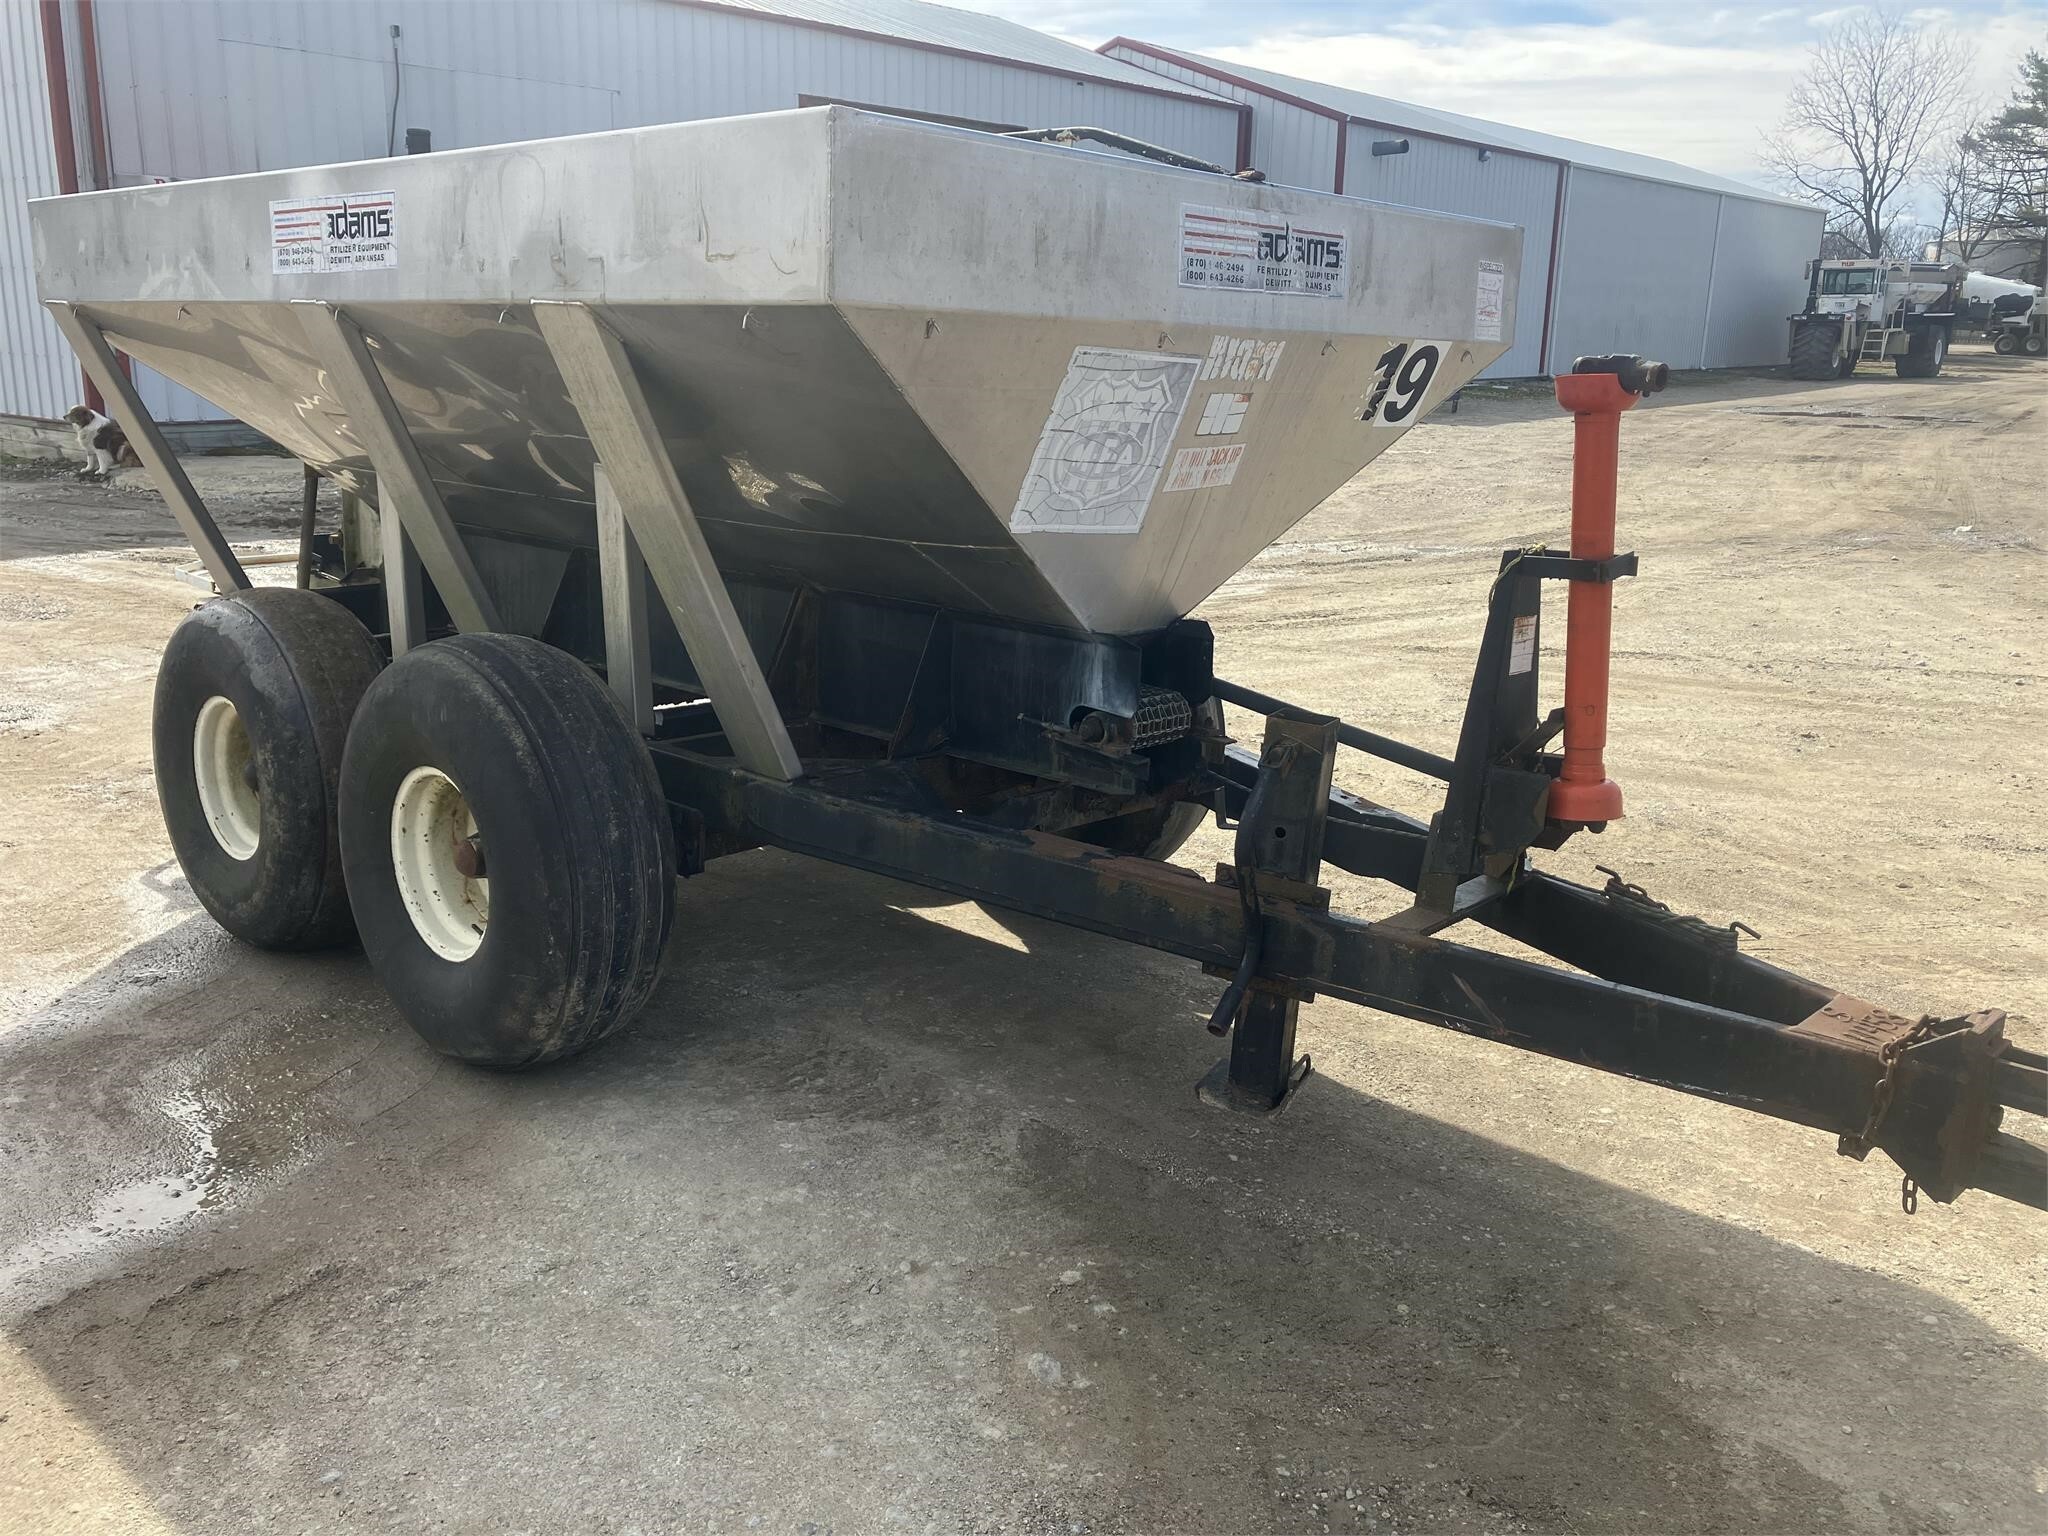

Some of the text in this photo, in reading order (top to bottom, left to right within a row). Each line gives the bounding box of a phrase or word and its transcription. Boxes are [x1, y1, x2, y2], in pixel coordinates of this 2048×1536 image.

[357, 243, 390, 252] EQUIPMENT
[1186, 257, 1244, 273] (870) 46-2494
[1186, 271, 1206, 282] (800)
[1360, 343, 1440, 423] 19
[1207, 447, 1231, 466] JACK
